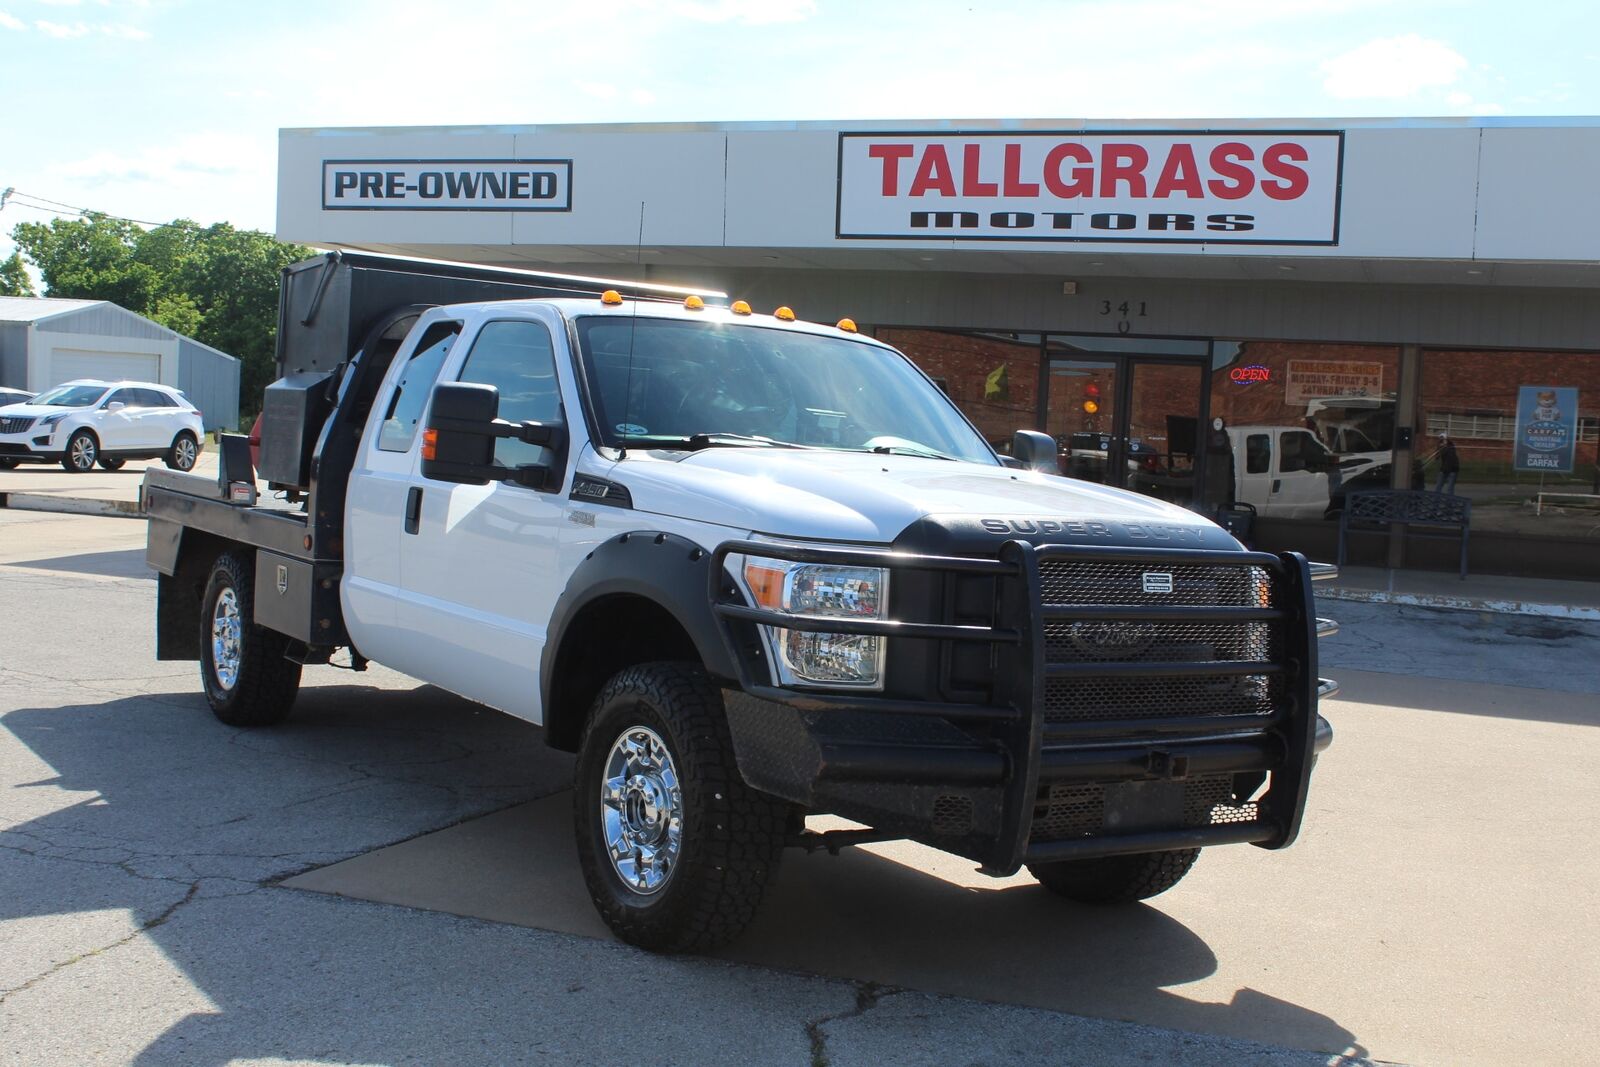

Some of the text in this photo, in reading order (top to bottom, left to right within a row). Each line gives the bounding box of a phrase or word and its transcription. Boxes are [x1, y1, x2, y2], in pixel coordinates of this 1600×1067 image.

[868, 142, 1309, 200] TALLGRASS
[334, 172, 558, 199] PRE-OWNED
[910, 211, 1255, 231] MOTORS
[1230, 367, 1270, 380] OPEN
[1527, 459, 1559, 467] CARFAX
[980, 518, 1204, 541] SUPER DUTY
